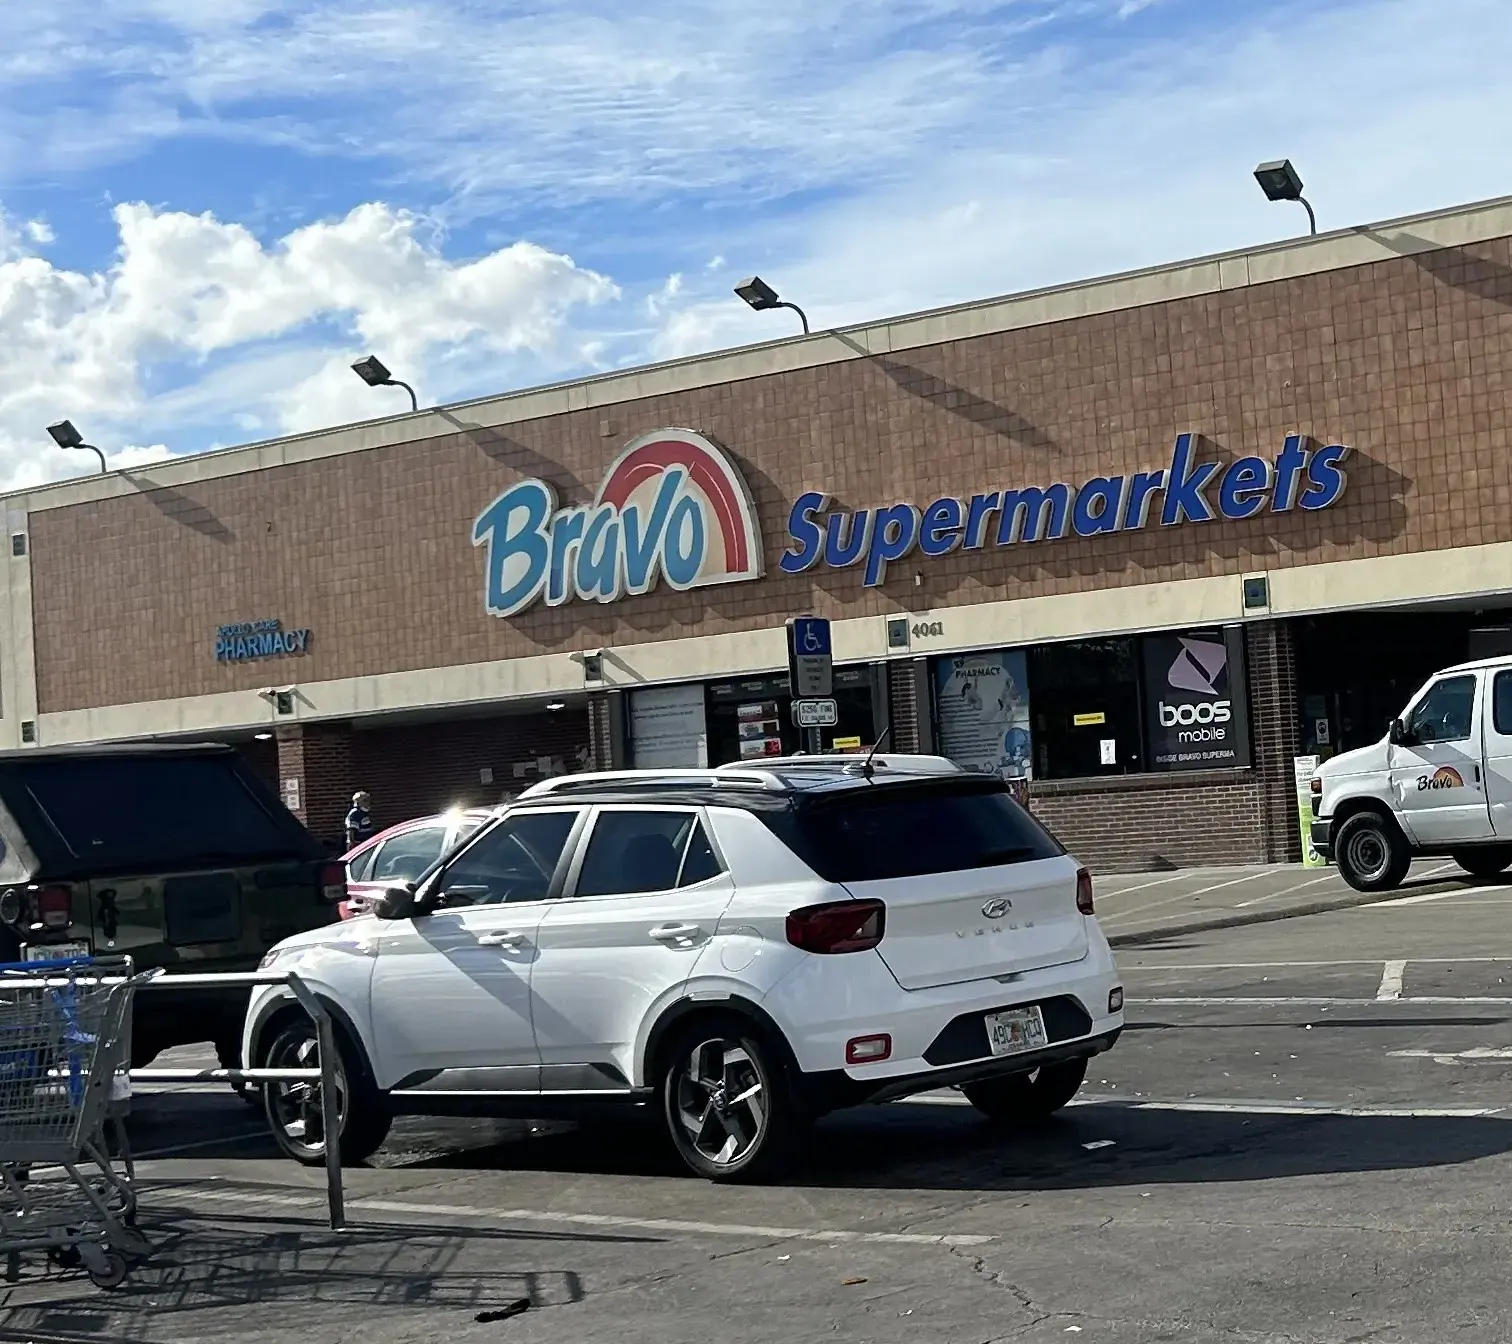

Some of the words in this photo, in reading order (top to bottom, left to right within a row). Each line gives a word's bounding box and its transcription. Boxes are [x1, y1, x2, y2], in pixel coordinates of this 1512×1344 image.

[779, 433, 1350, 587] Supermarkets
[473, 464, 708, 617] Bravo
[911, 622, 945, 639] 4061
[214, 629, 310, 660] PHARMACY
[1159, 700, 1231, 727] boos
[1178, 726, 1226, 743] mobile
[1416, 774, 1453, 791] Bravo
